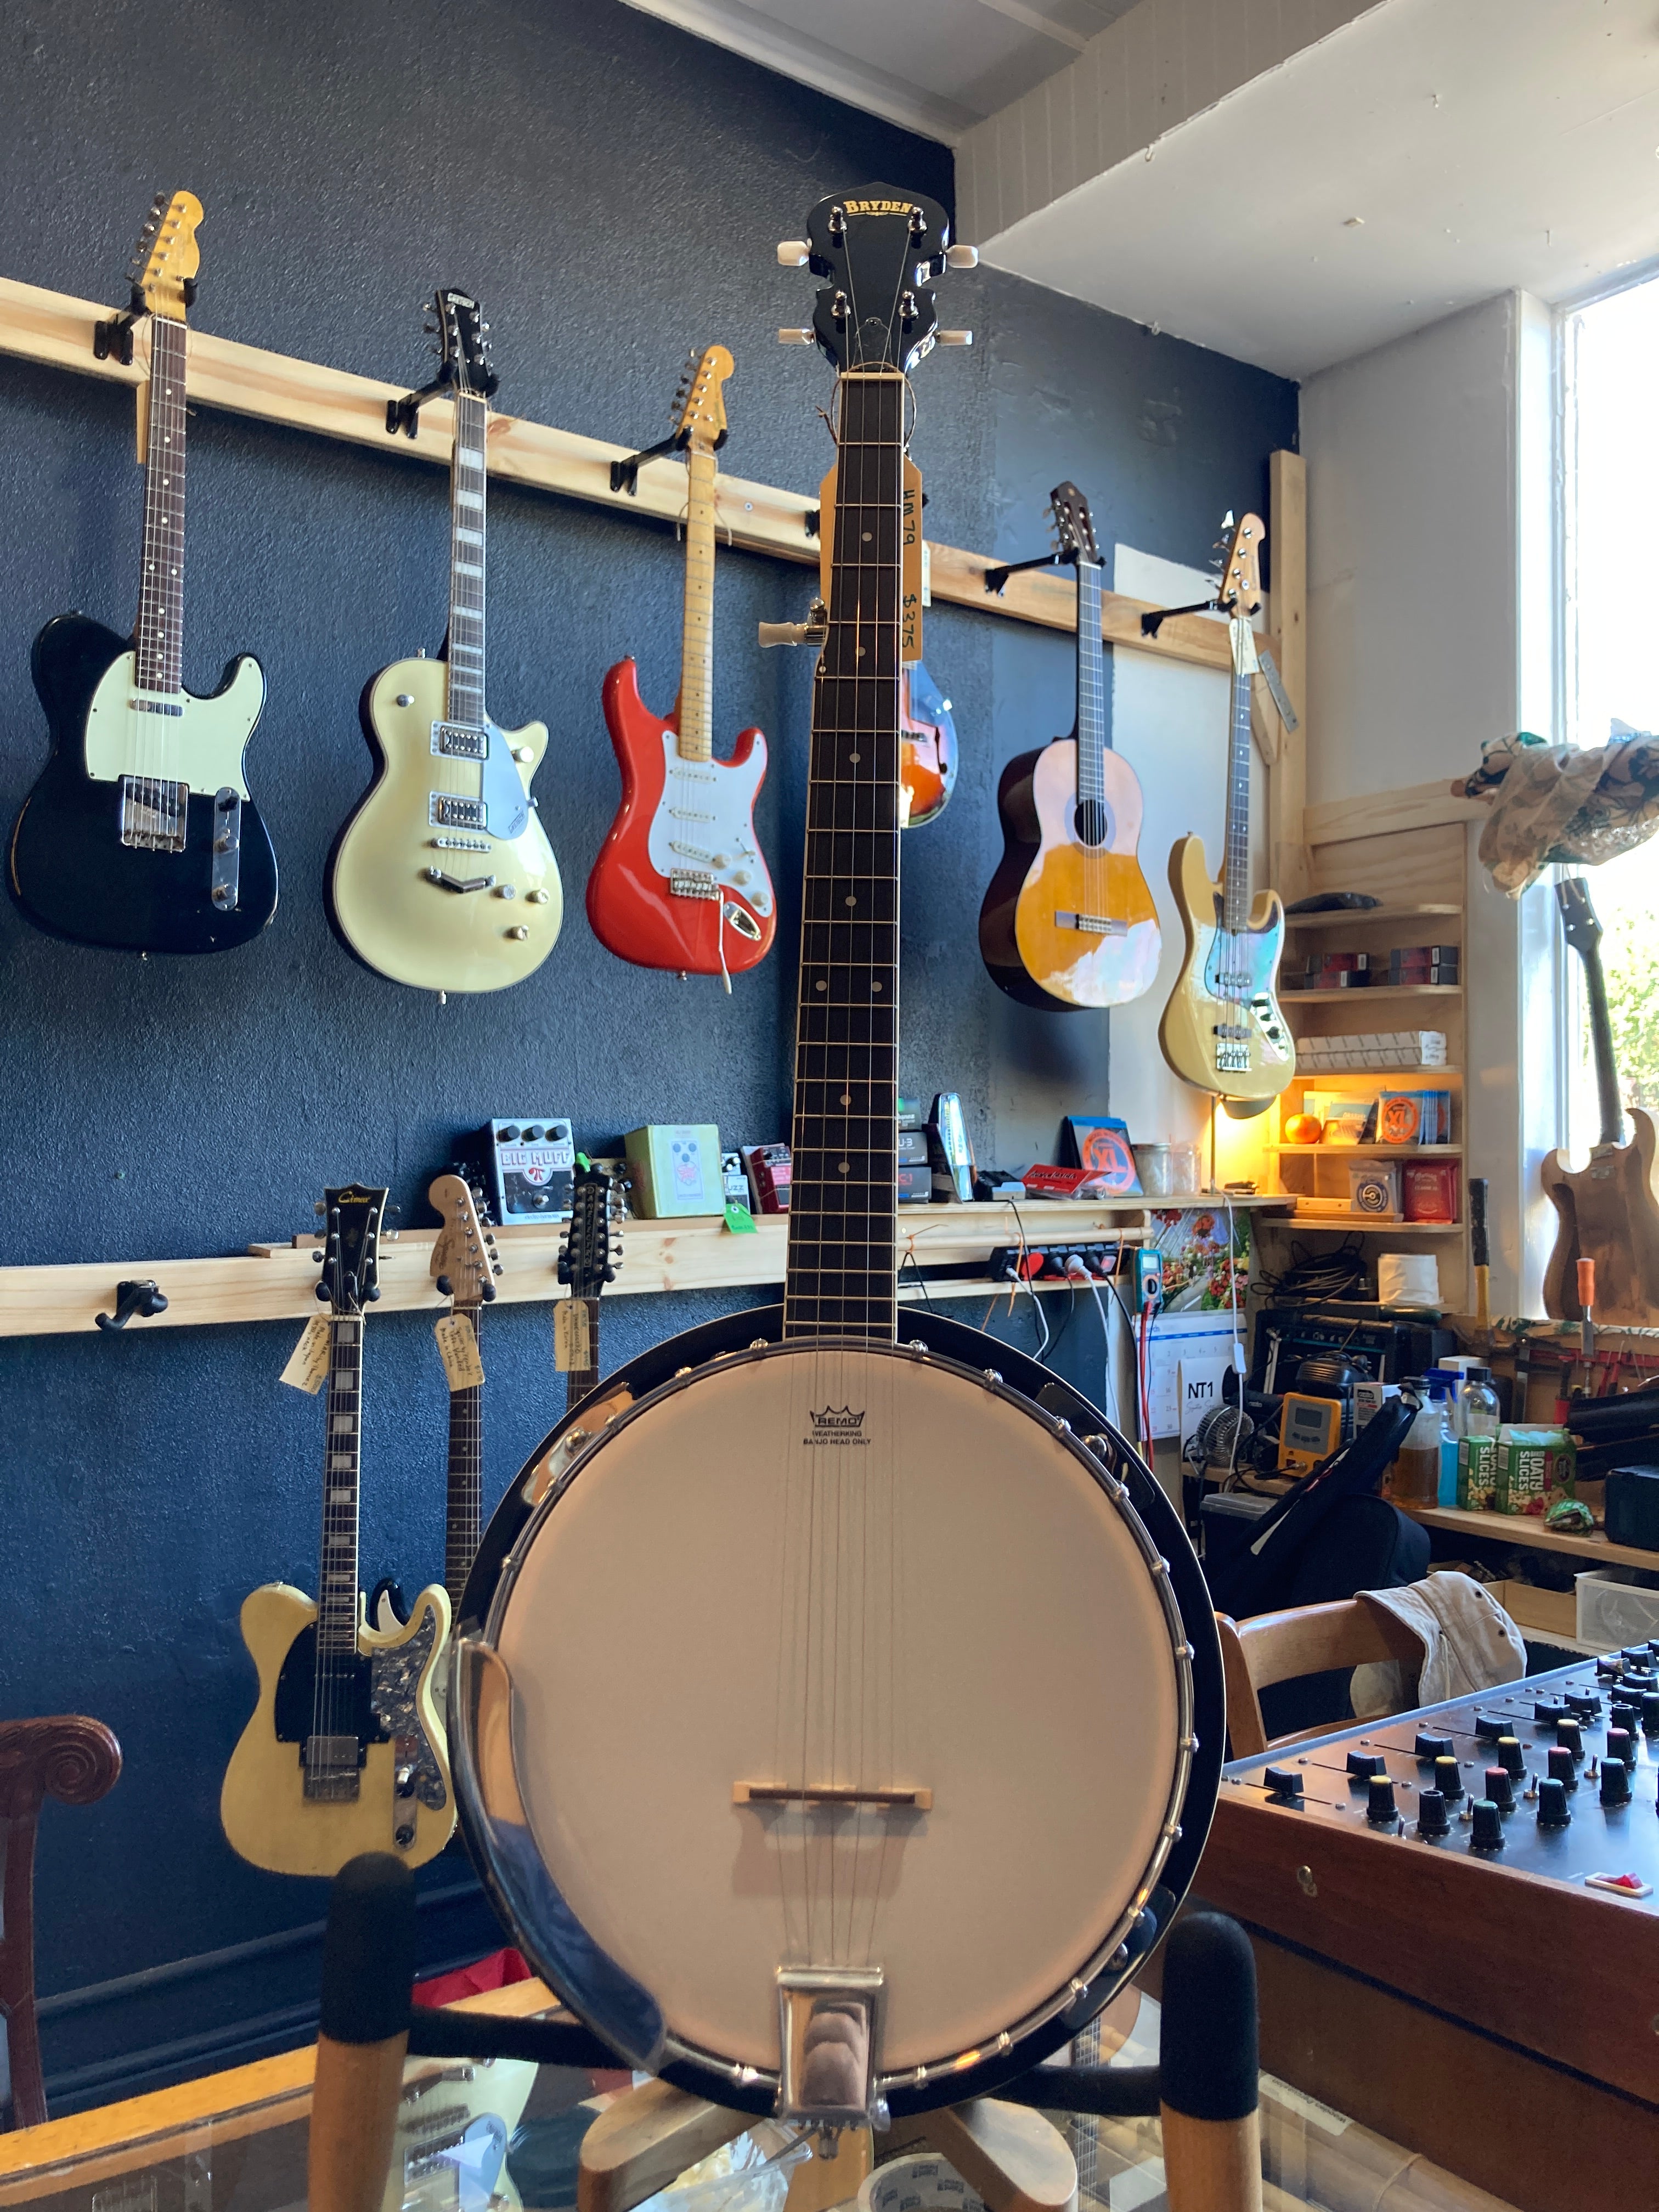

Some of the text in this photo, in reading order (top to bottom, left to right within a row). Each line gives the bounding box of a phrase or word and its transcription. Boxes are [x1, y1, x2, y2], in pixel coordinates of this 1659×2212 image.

[843, 200, 913, 213] BRYDEN
[902, 594, 917, 650] $375
[501, 1152, 571, 1166] BIG MUFF
[1093, 1148, 1128, 1173] XL
[1188, 1381, 1214, 1399] NT1
[1479, 1446, 1491, 1486] SLICES
[1518, 1451, 1531, 1491] SLICES
